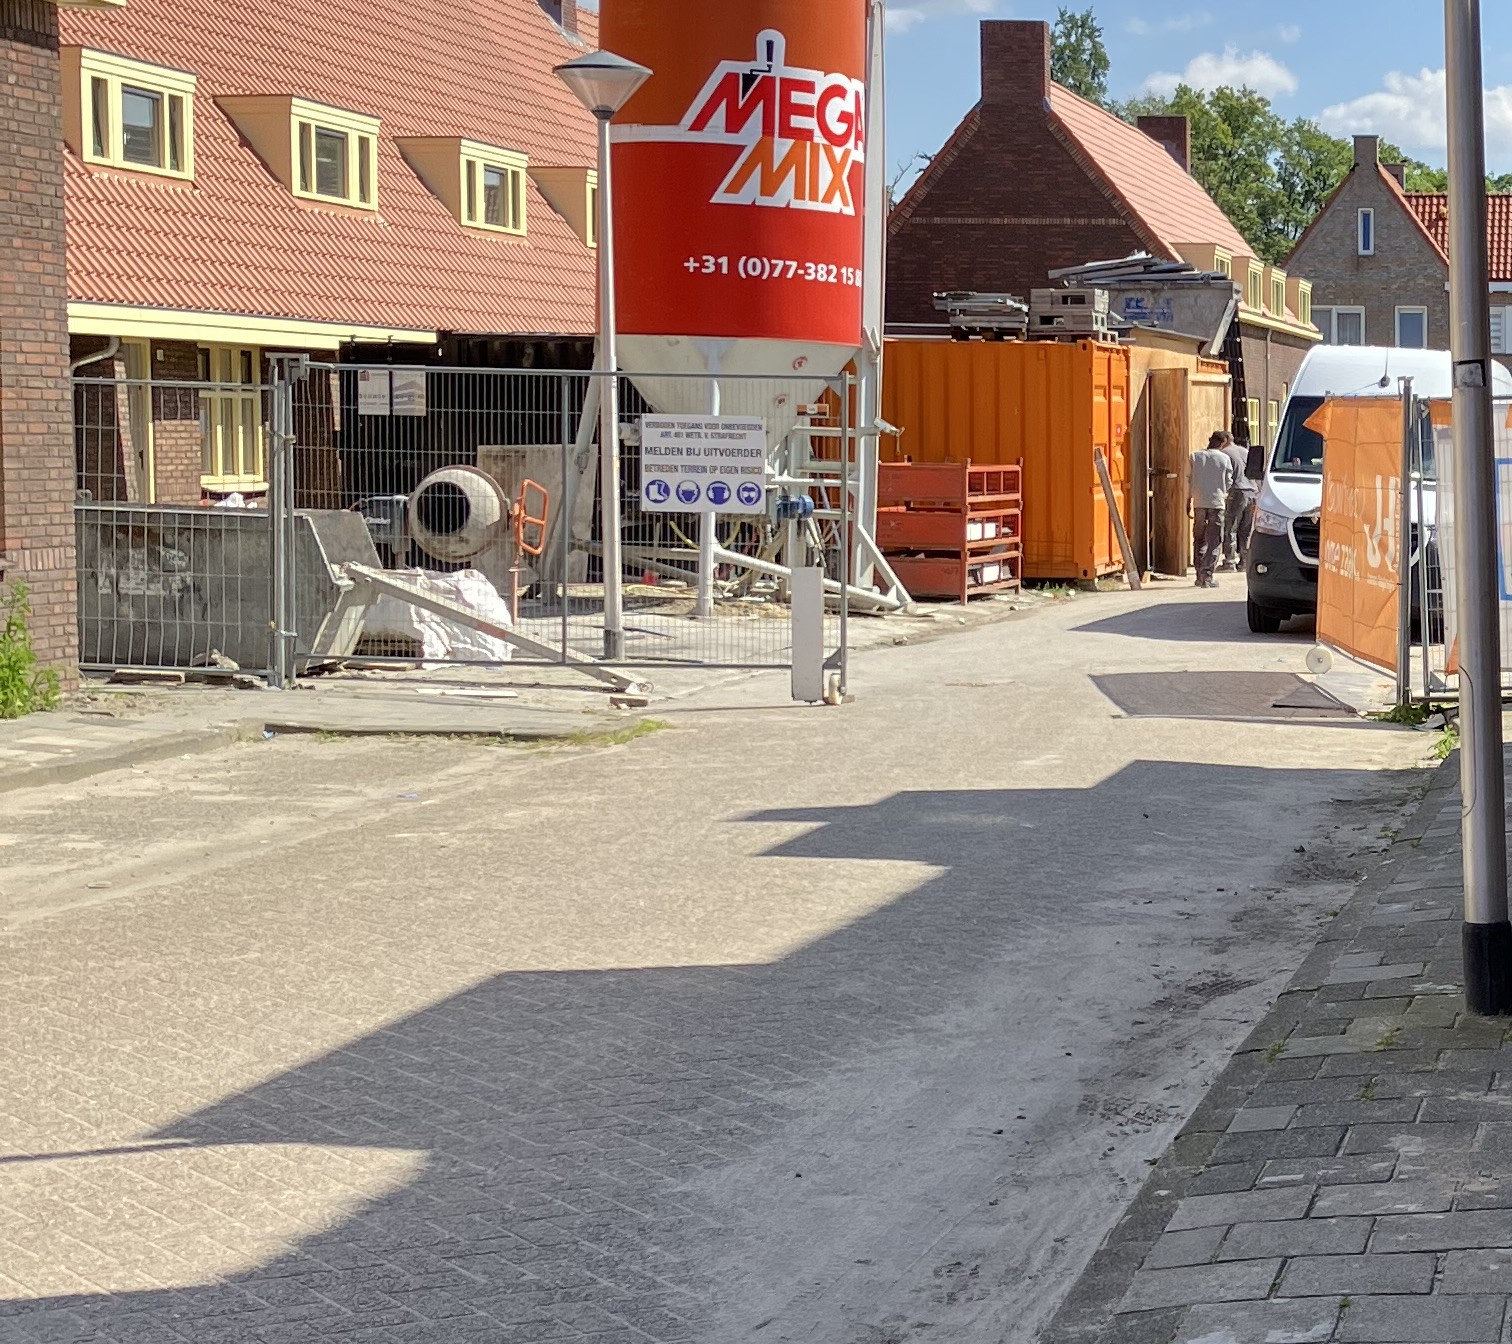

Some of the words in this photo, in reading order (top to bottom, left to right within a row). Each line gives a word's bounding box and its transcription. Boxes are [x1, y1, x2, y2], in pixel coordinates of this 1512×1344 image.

[688, 72, 864, 151] MEGA
[723, 133, 852, 208] MIX
[683, 255, 729, 275] +31
[737, 256, 838, 283] (0)77-382
[840, 266, 854, 286] 15
[644, 446, 684, 456] MELDEN
[686, 447, 701, 457] BIJ
[703, 448, 763, 458] UITVOERDER
[644, 464, 679, 473] BETREDEN
